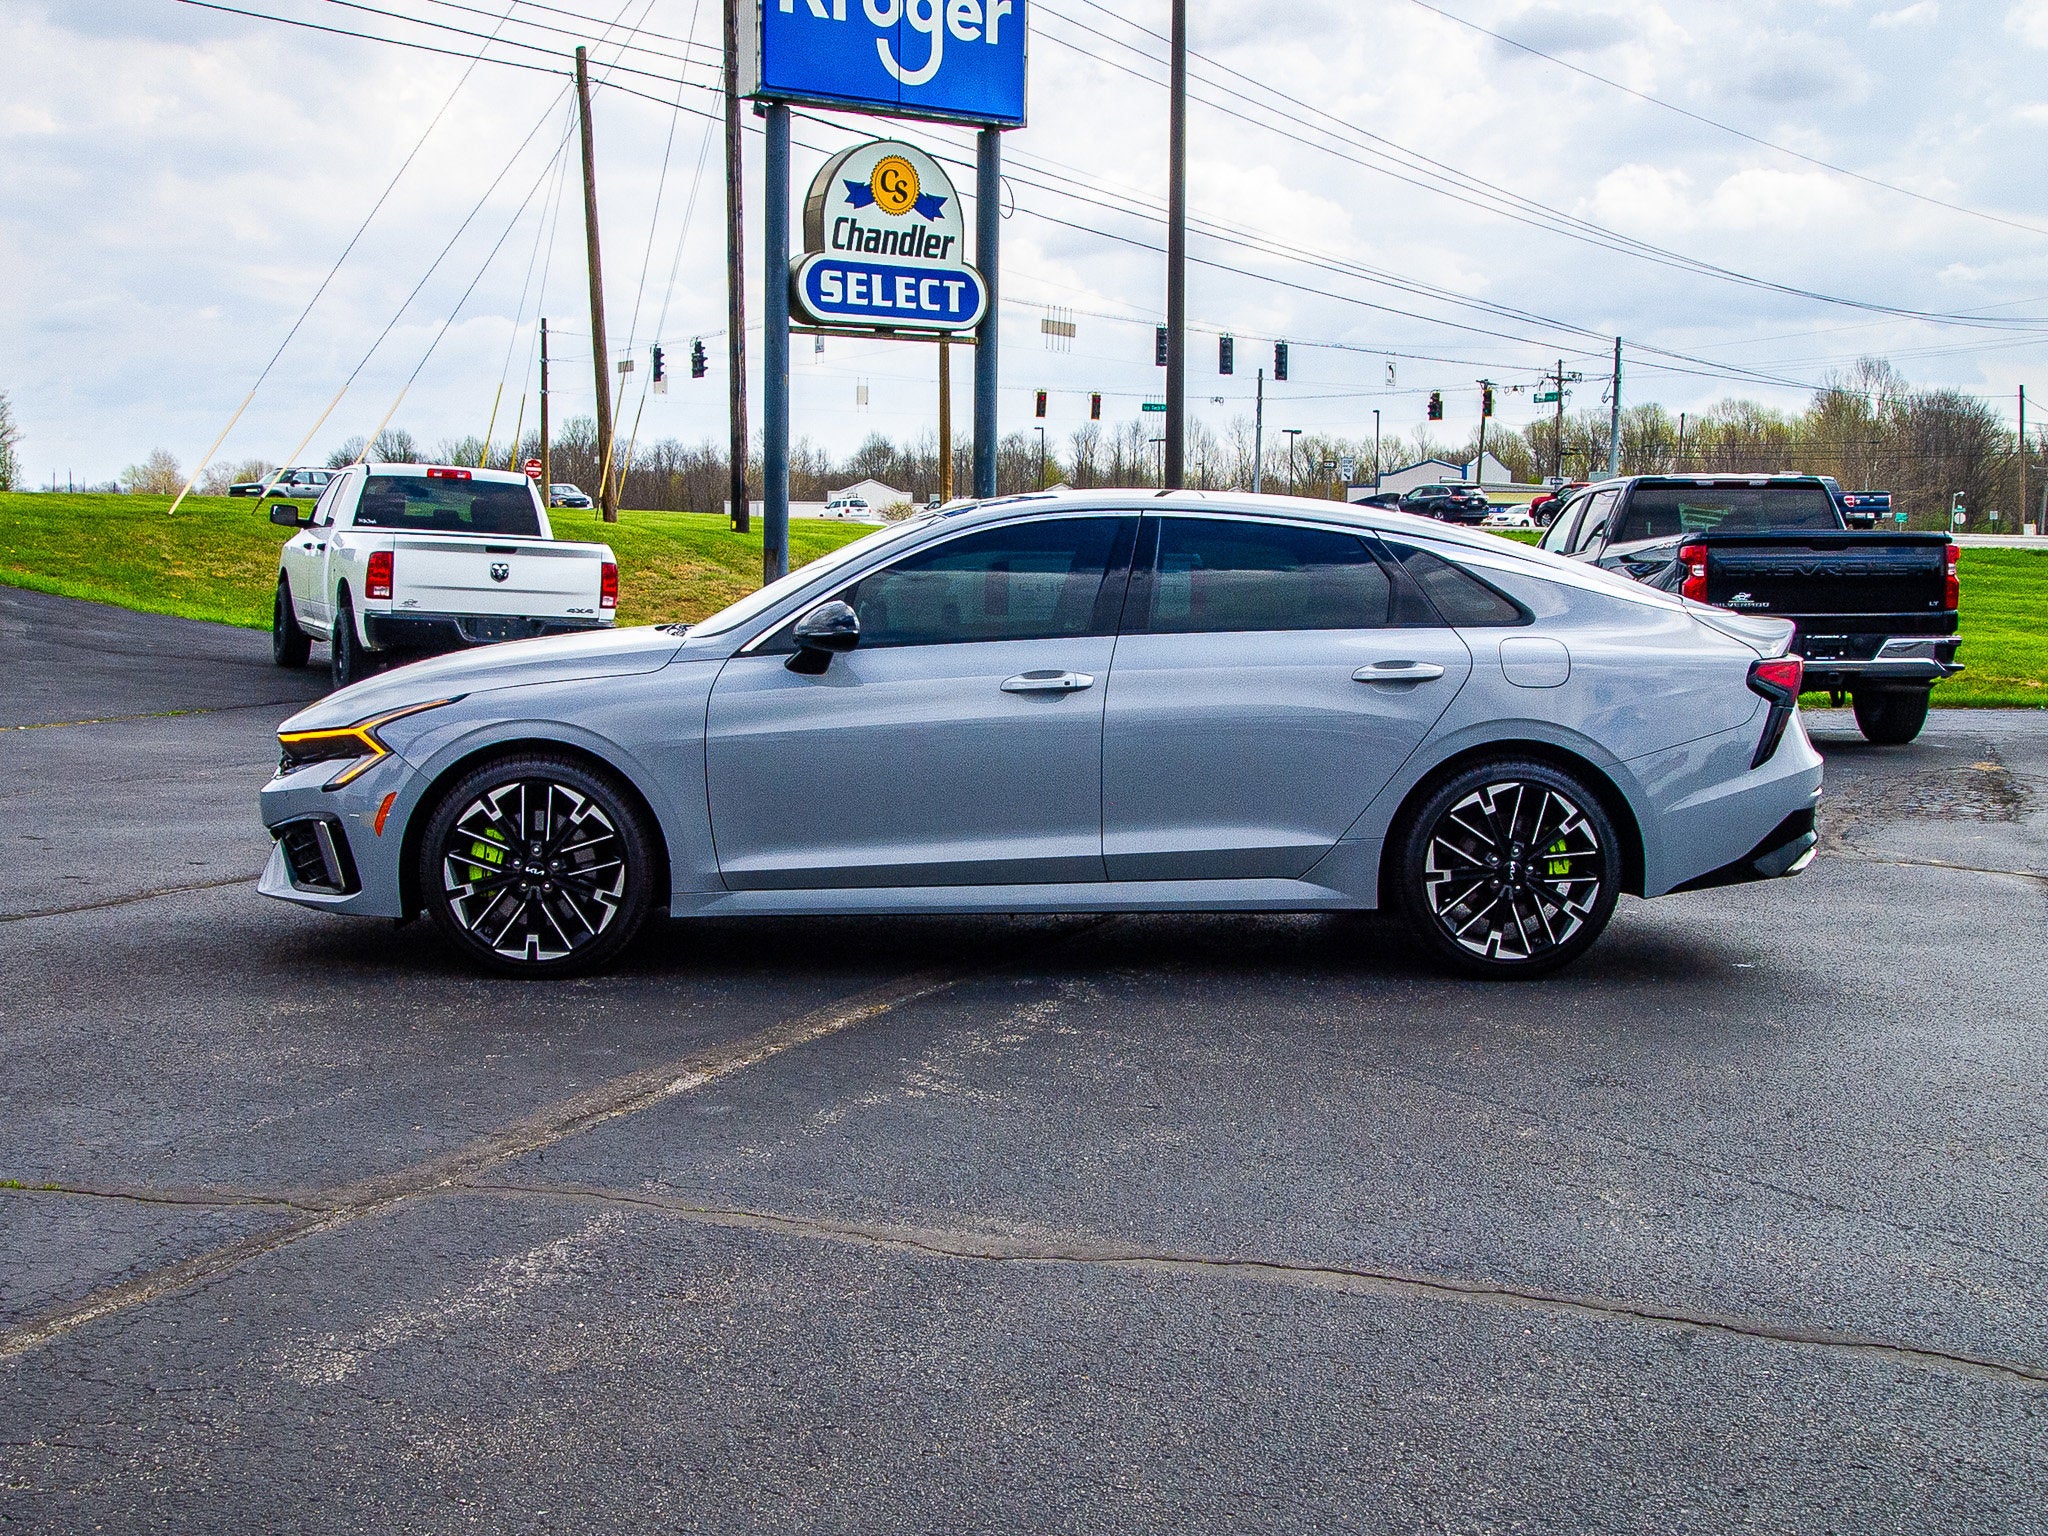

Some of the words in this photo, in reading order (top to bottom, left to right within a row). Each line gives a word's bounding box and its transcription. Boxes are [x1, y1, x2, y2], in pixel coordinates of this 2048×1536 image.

[779, 0, 1012, 86] oger
[832, 216, 955, 260] Chandler
[820, 269, 966, 313] SELECT
